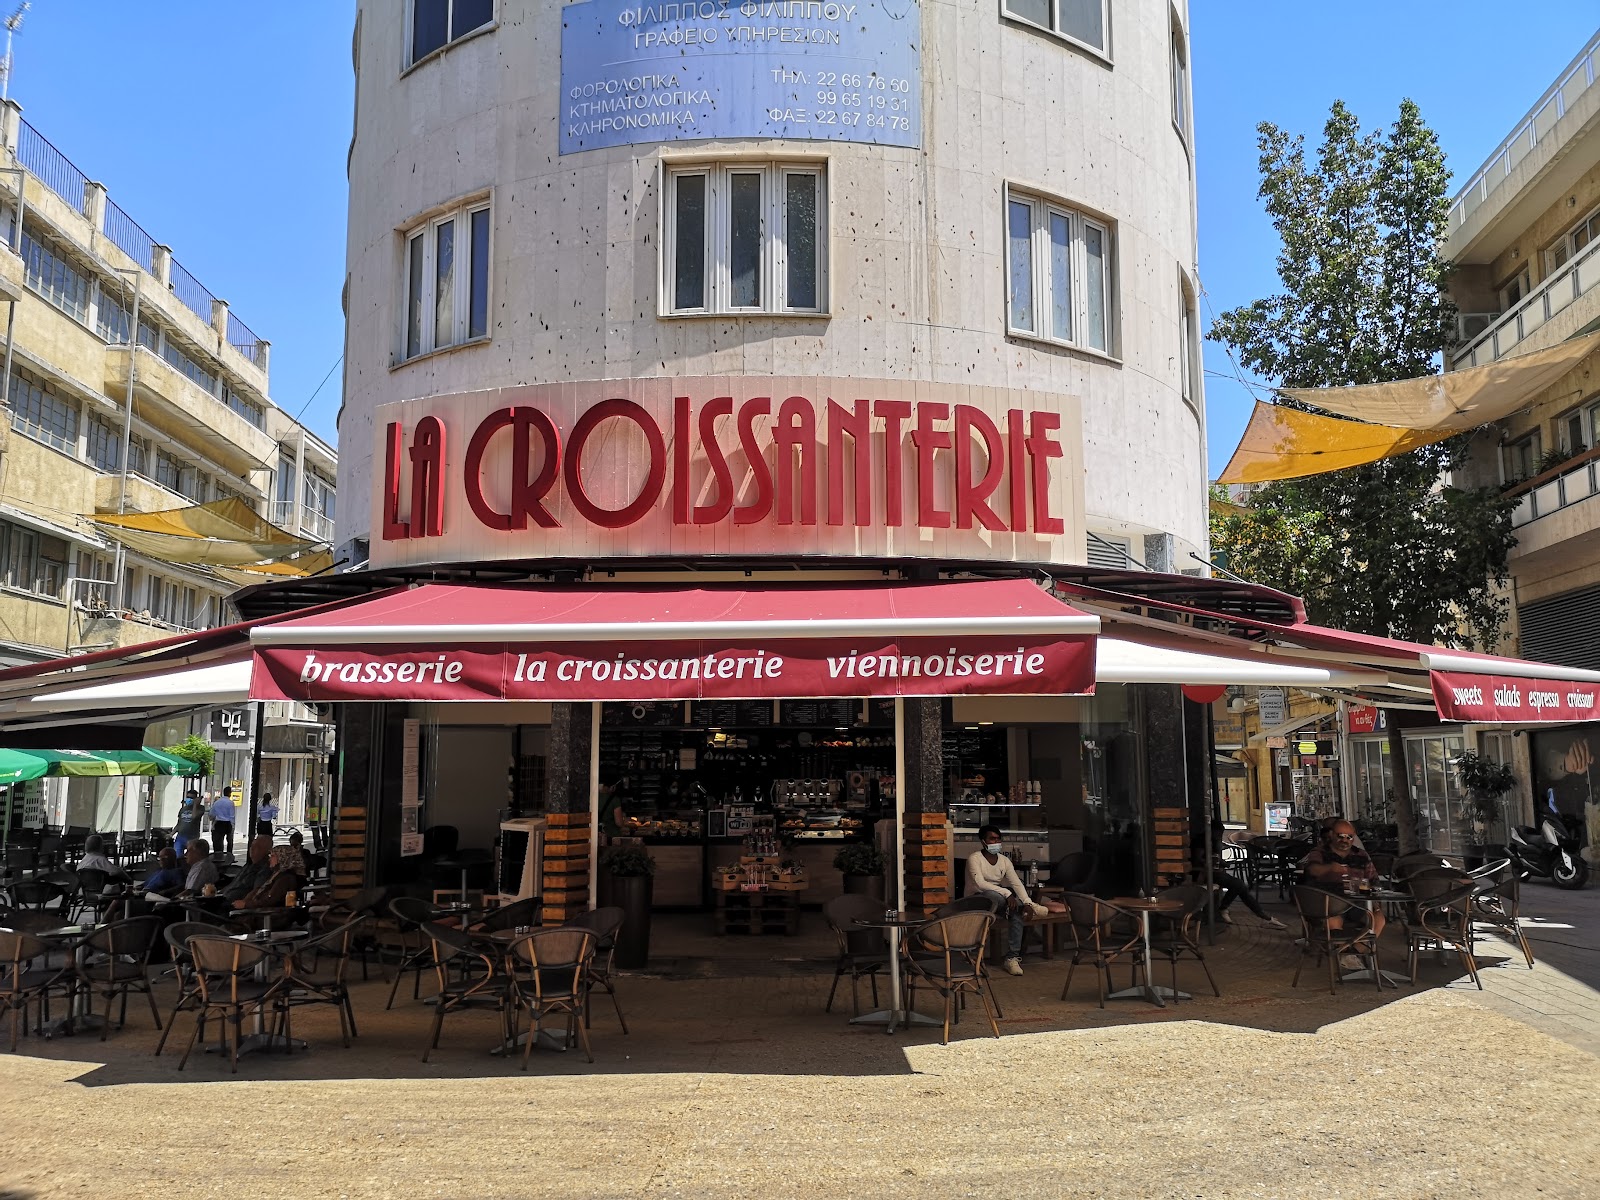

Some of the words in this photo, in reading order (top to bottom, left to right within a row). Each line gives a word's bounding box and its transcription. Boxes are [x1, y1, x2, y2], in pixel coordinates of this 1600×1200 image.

[618, 1, 730, 27] ΦΙΛΙΠΠΟΣ
[740, 0, 856, 23] ΦΙΛΙΠΠΟΥ
[635, 27, 718, 49] ΓΡΑΦΕΙΟ
[725, 26, 840, 45] ΥΠΗΡΕΣΙΩΝ
[570, 74, 680, 100] ΦΟΡΟΛΟΓΙΚΑ
[816, 71, 837, 86] 22
[841, 73, 861, 88] 66
[866, 75, 886, 90] 76
[890, 78, 909, 93] 60
[570, 90, 711, 119] ΚΤΗΜΑΤΟΛΟΓΙΚΑ
[816, 91, 837, 105] 99
[841, 92, 861, 107] 65
[867, 95, 886, 109] 19
[890, 97, 908, 112] 31
[569, 110, 694, 138] ΚΛΗΡΟΝΟΜΙΚΑ
[816, 110, 837, 124] 22
[841, 112, 861, 126] 67
[866, 113, 886, 129] 84
[890, 116, 909, 131] 78
[382, 414, 446, 542] LA
[464, 396, 1065, 536] CROISSANTERIE
[300, 655, 463, 684] brasserie
[513, 653, 548, 683] la
[556, 650, 784, 682] croissanterie
[827, 647, 1045, 678] viennoiserie
[1452, 685, 1484, 707] sweets
[1494, 684, 1521, 708] salads
[1529, 690, 1560, 713] espresso
[1567, 688, 1595, 709] croissant
